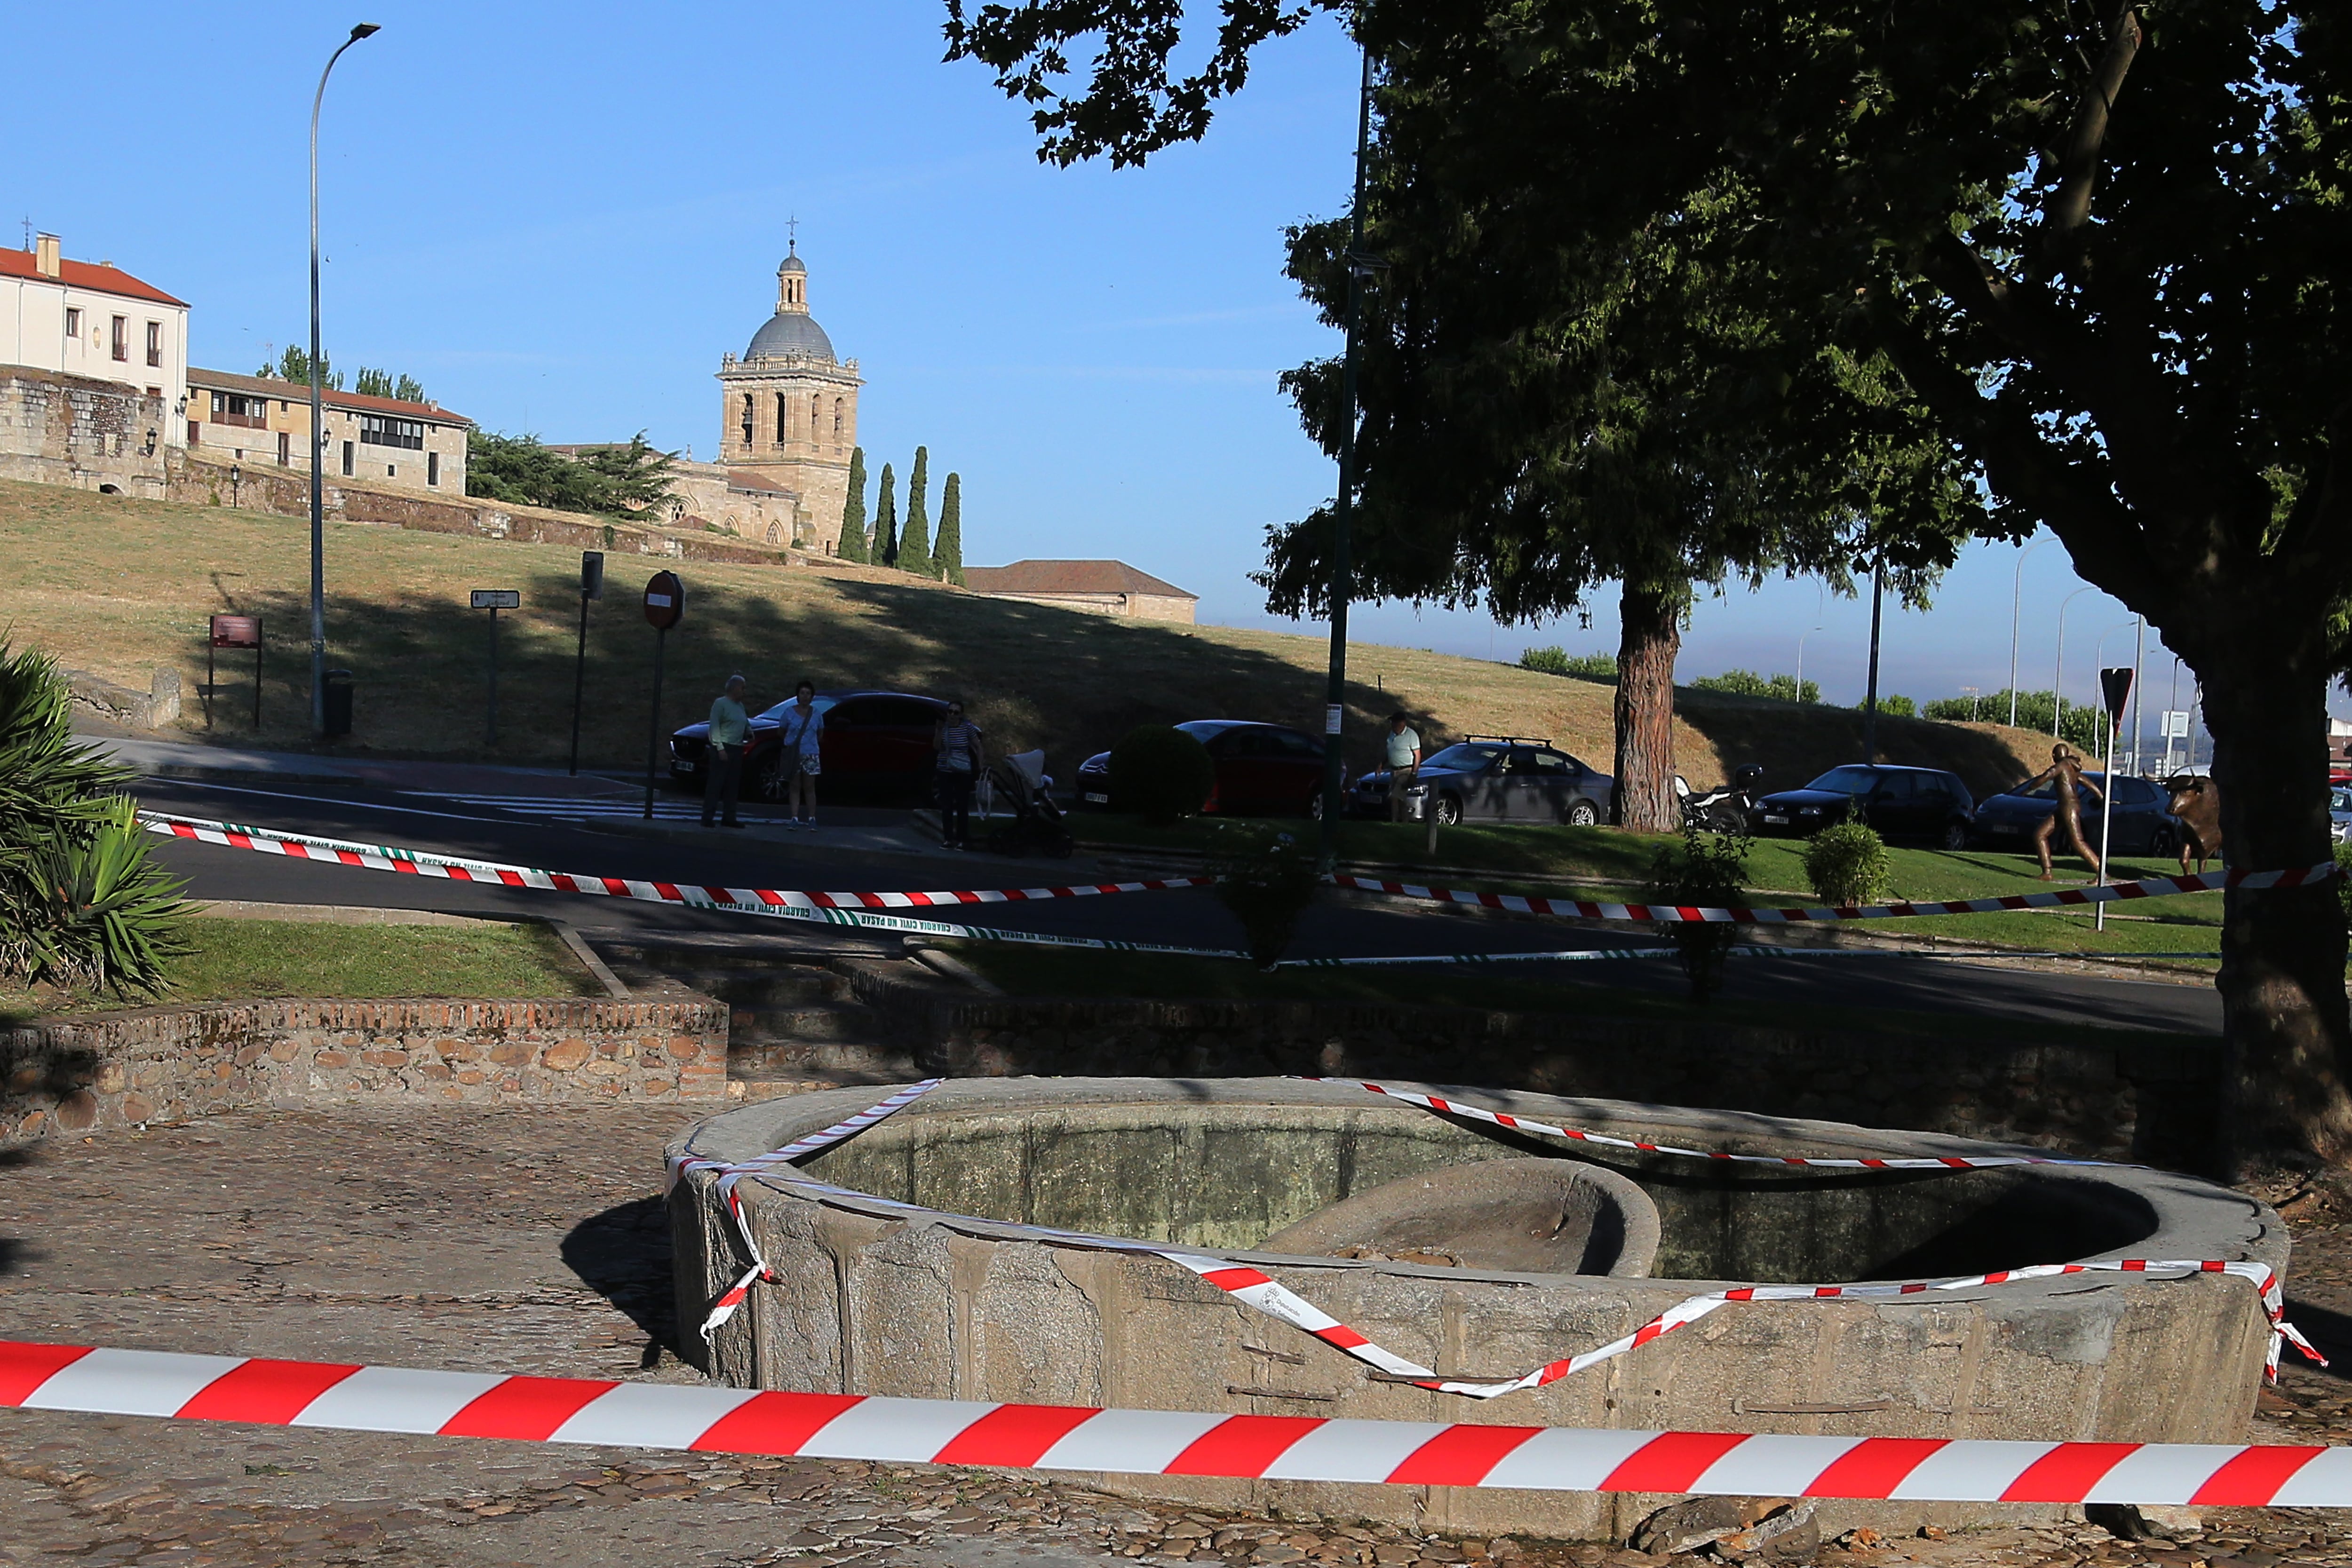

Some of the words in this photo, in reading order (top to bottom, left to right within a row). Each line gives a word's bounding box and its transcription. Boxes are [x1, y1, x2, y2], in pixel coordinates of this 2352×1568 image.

[758, 904, 776, 914] CIVIL
[778, 905, 810, 918] GUARDIA
[861, 915, 885, 926] PASAR
[887, 918, 898, 927] NO
[899, 919, 917, 929] CIVIL
[919, 921, 951, 932] GUARDIA
